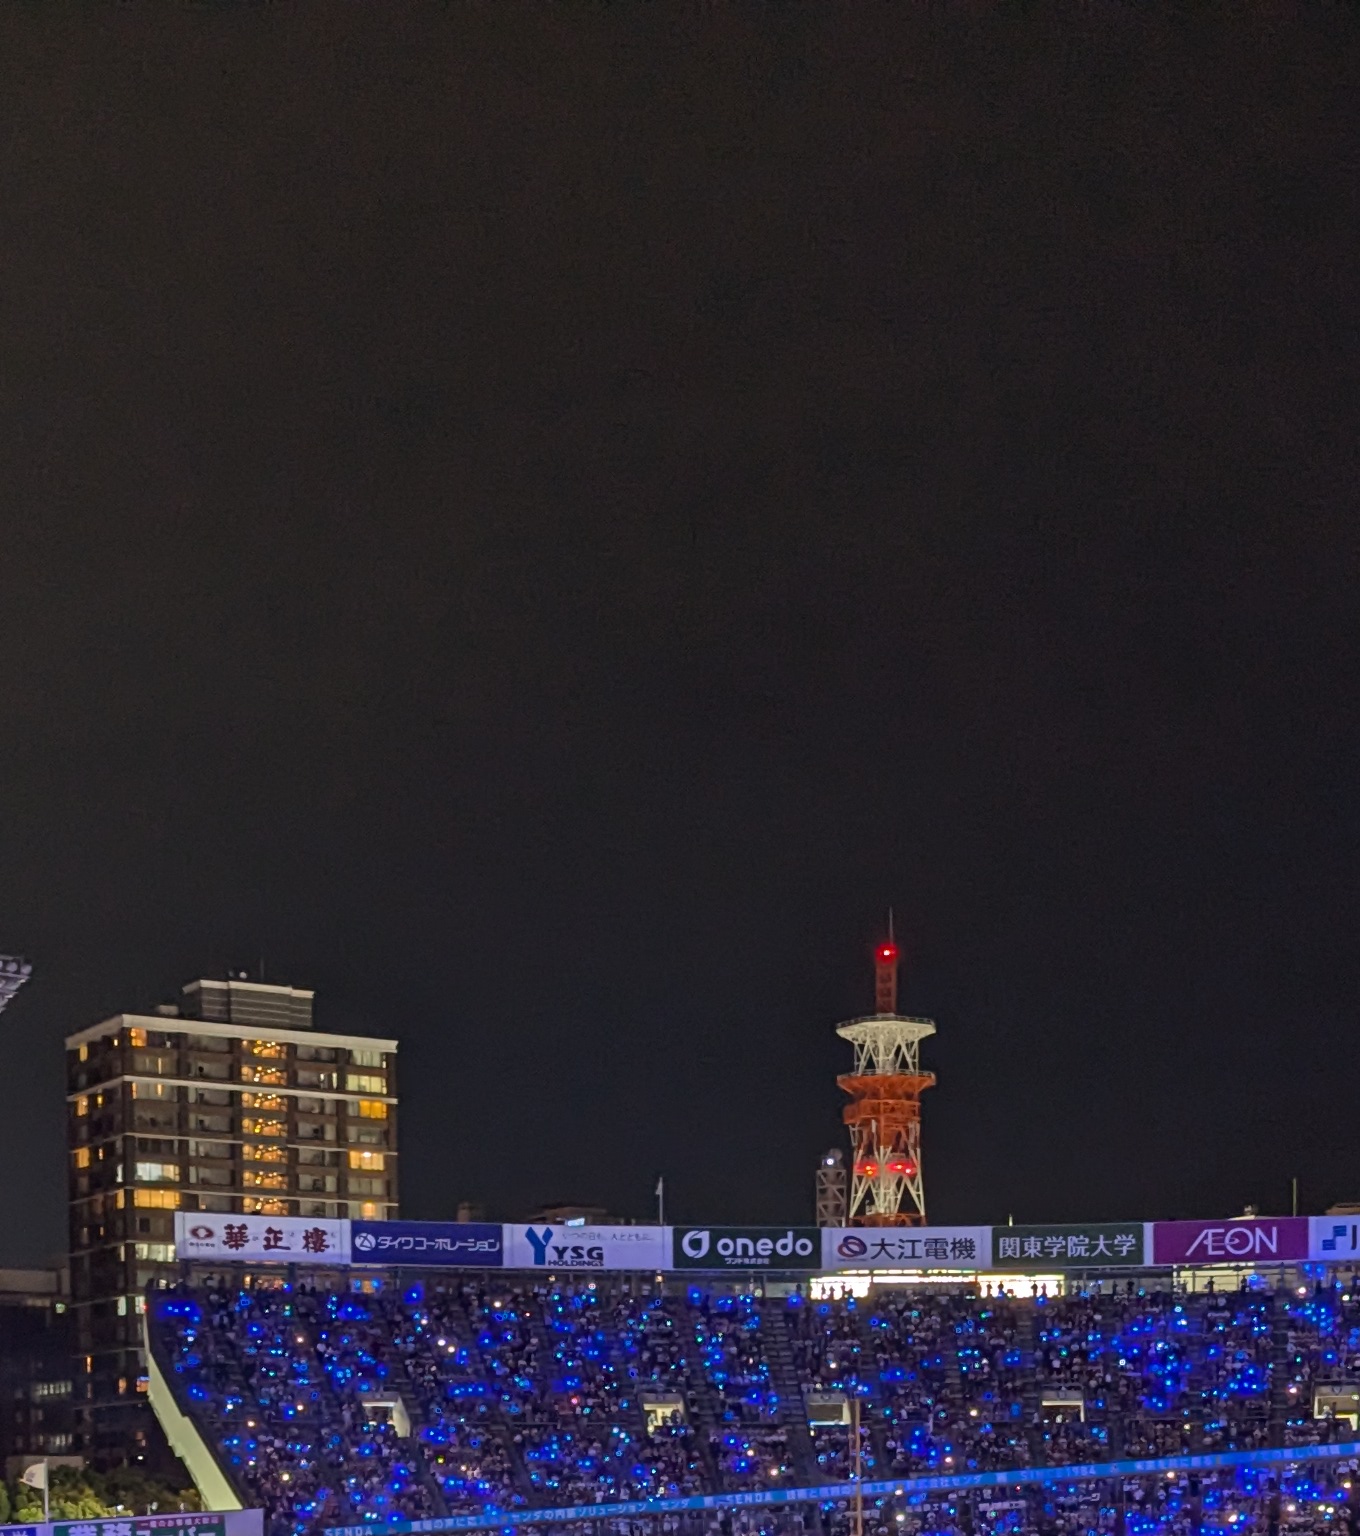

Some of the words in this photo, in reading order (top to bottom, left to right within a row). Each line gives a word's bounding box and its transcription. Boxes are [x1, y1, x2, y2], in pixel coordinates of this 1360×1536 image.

[378, 1235, 501, 1252] ダイワコーポレーション
[551, 1245, 604, 1260] YSG
[717, 1231, 814, 1257] onedo
[870, 1237, 977, 1261] 大江電機
[998, 1233, 1137, 1259] 関東学院大学
[547, 1259, 604, 1267] HOLDINGS
